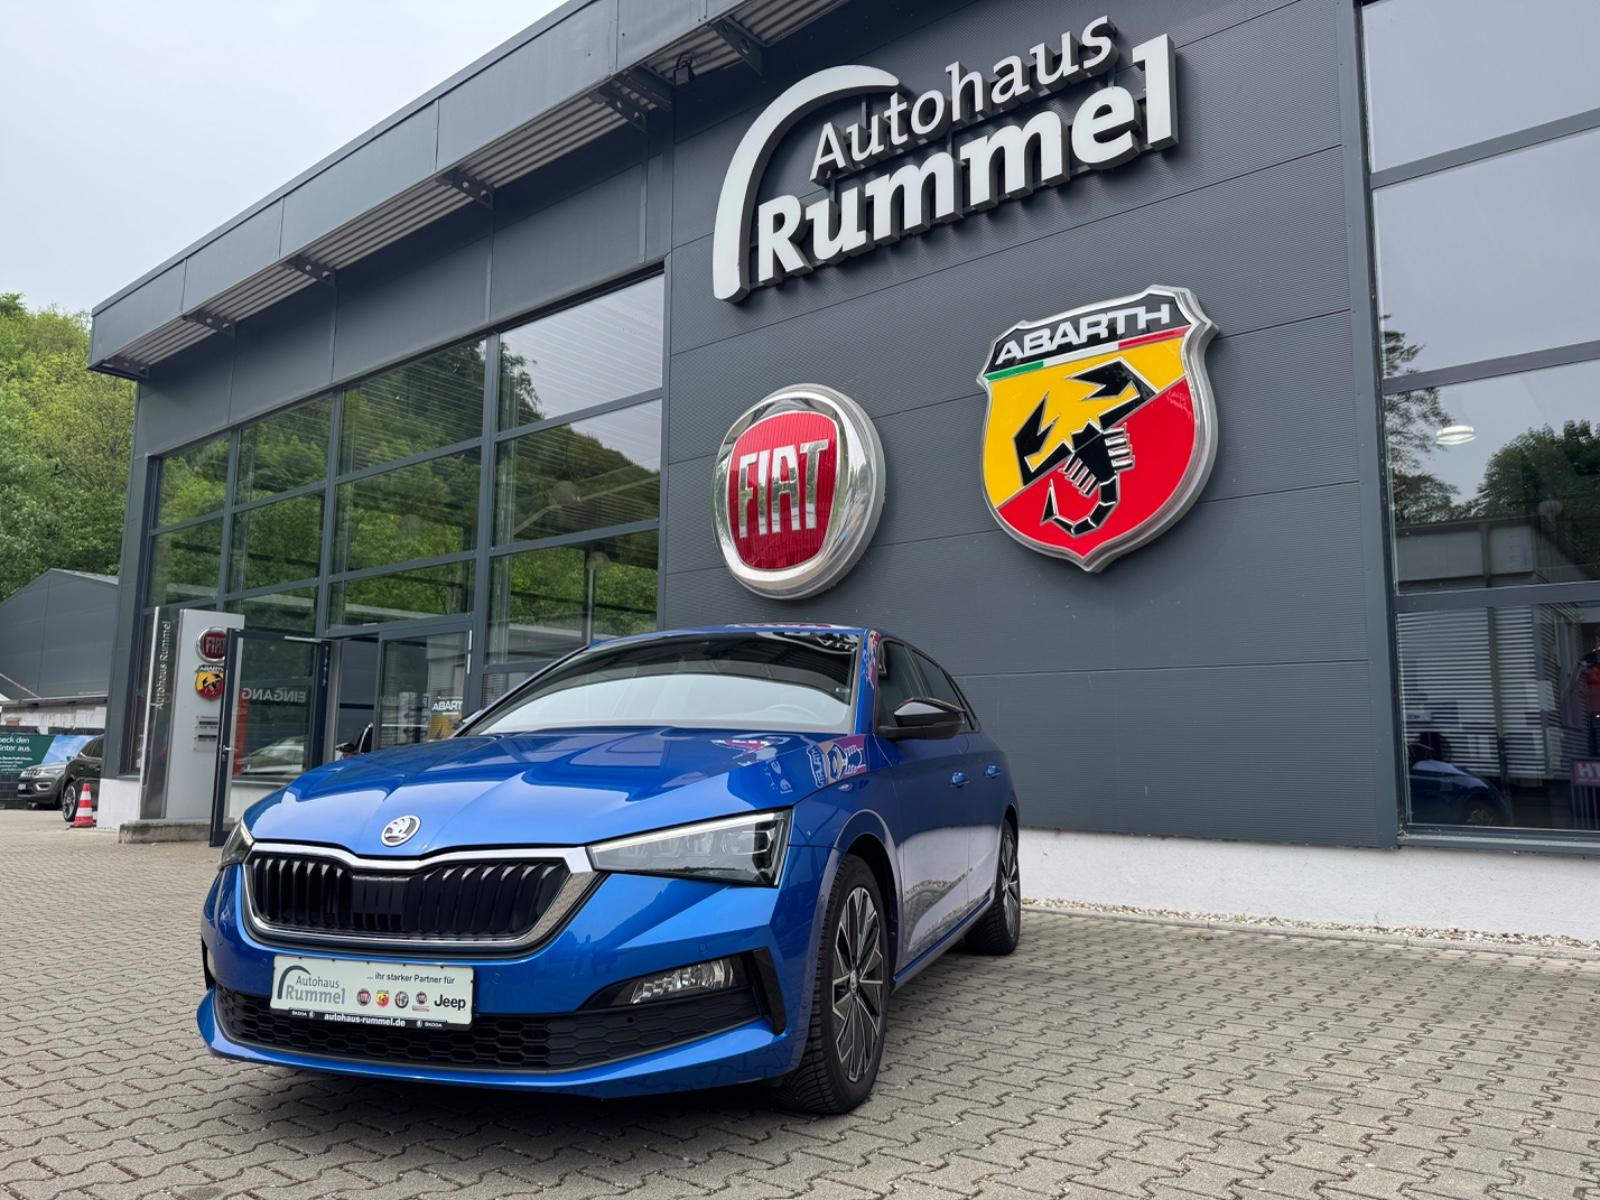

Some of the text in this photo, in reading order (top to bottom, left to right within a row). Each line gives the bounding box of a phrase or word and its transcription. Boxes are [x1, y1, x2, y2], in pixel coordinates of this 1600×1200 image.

[809, 15, 1116, 184] Autohaus
[758, 33, 1177, 283] Rummel
[996, 304, 1170, 366] ABARTH
[738, 439, 828, 538] FIAT
[296, 975, 340, 989] Autohaus
[386, 973, 412, 983] starker
[414, 974, 441, 983] Partner
[444, 976, 455, 985] für
[286, 984, 346, 1004] Rummel
[434, 994, 466, 1011] Jeep
[324, 1013, 406, 1027] autohaus-rummel.de
